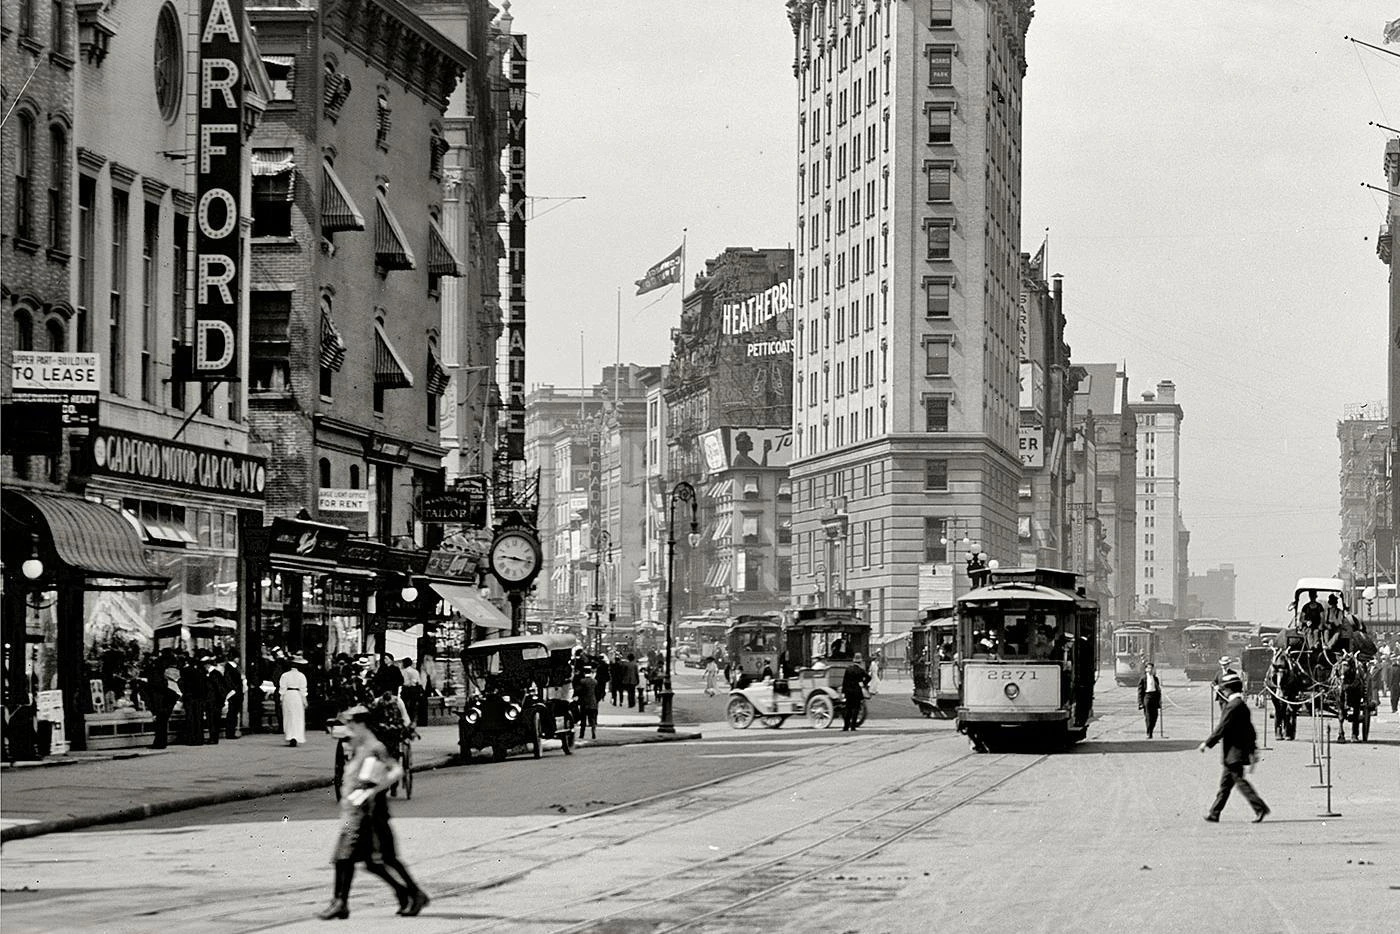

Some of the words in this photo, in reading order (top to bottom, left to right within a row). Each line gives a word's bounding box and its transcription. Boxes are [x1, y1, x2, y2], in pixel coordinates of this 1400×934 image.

[508, 35, 526, 111] NEW
[508, 118, 526, 222] YORK
[722, 279, 795, 335] HEATHERBL
[506, 247, 526, 434] THEATRE
[14, 366, 34, 380] TO
[43, 368, 96, 382] LEASE
[106, 434, 161, 478] GARFORD
[320, 499, 336, 507] FOR
[340, 500, 363, 508] RENT
[424, 508, 467, 518] TAILOR
[987, 670, 1039, 681] 2271
